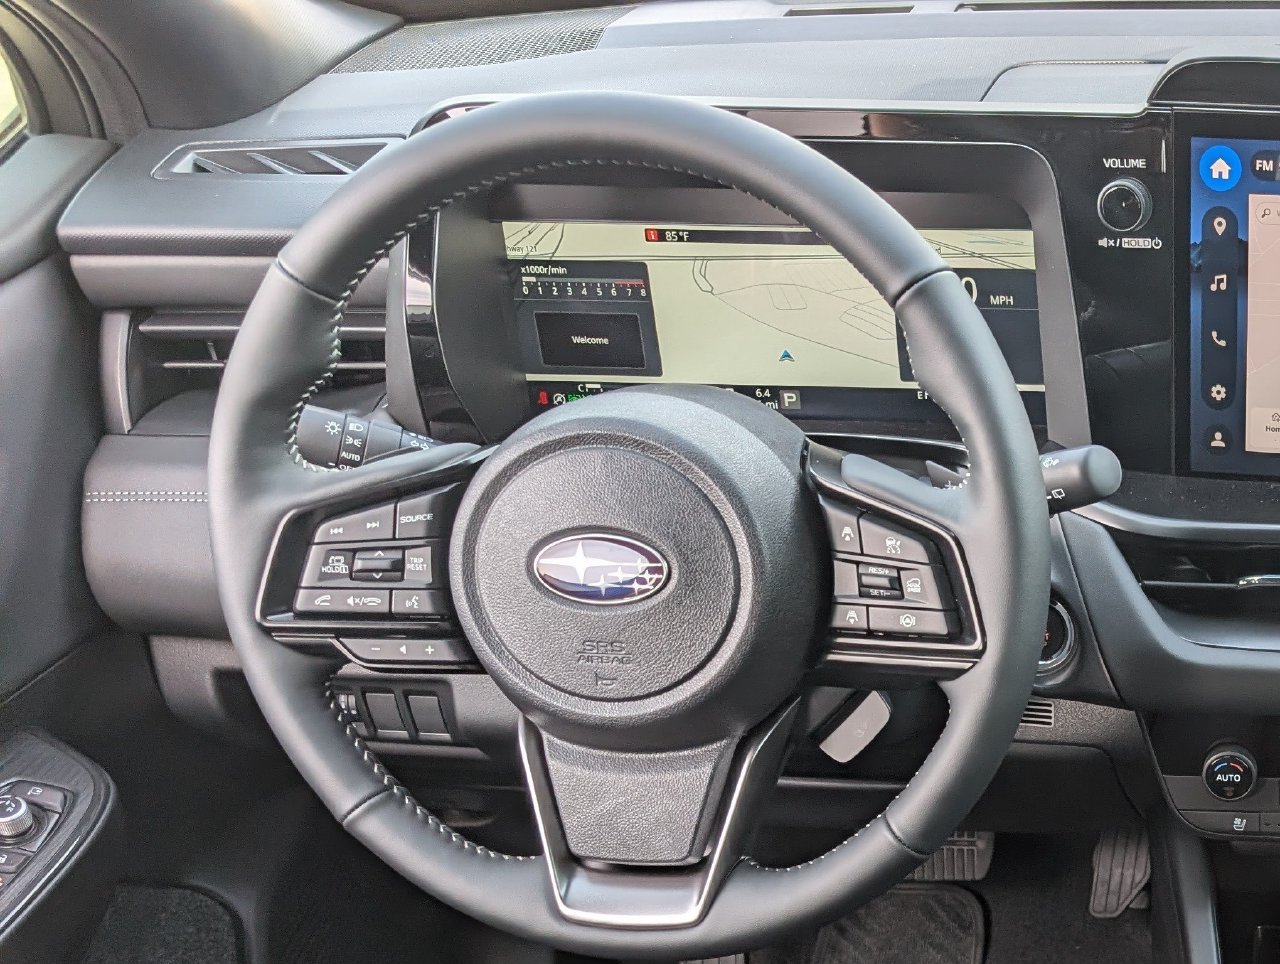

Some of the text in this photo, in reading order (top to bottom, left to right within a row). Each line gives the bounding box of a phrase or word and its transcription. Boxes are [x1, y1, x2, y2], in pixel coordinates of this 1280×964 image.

[1103, 158, 1147, 169] VOLUME
[1255, 159, 1273, 171] FM
[1123, 238, 1150, 247] HOLD
[521, 265, 568, 275] x1000r/min
[522, 286, 647, 297] 0 1 2 3 4 5 6 7 8
[990, 294, 1014, 306] MPH
[571, 335, 609, 345] Welcome
[755, 388, 771, 398] 6.4
[783, 393, 797, 407] P
[341, 451, 361, 462] AUTO
[400, 513, 434, 523] SOURCE
[409, 557, 424, 565] TRIP
[406, 563, 428, 572] RESET
[576, 655, 632, 665] AIRBAG
[1216, 774, 1241, 782] AUTO
